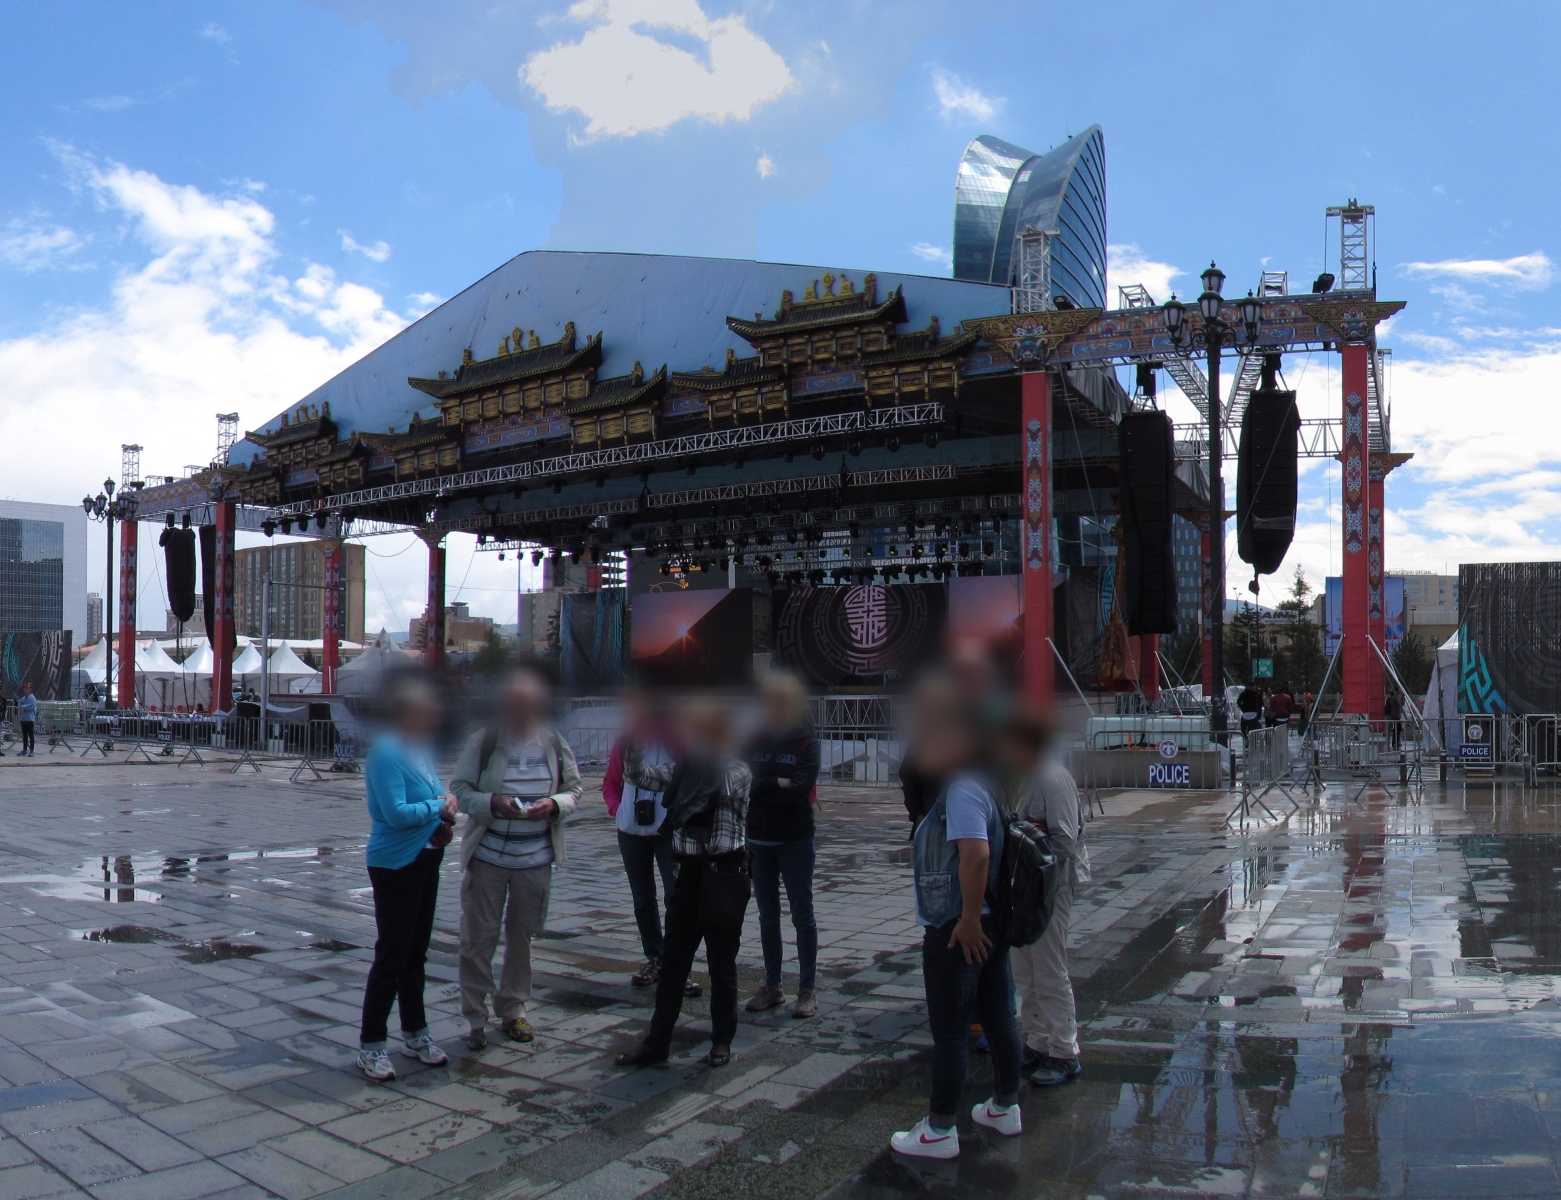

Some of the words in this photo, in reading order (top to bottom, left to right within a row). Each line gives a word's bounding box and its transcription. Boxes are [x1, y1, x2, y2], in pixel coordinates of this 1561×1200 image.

[158, 733, 171, 741] POLICE
[333, 744, 354, 758] POLICE
[1462, 747, 1489, 756] POLICE
[1149, 764, 1190, 784] POLICE
